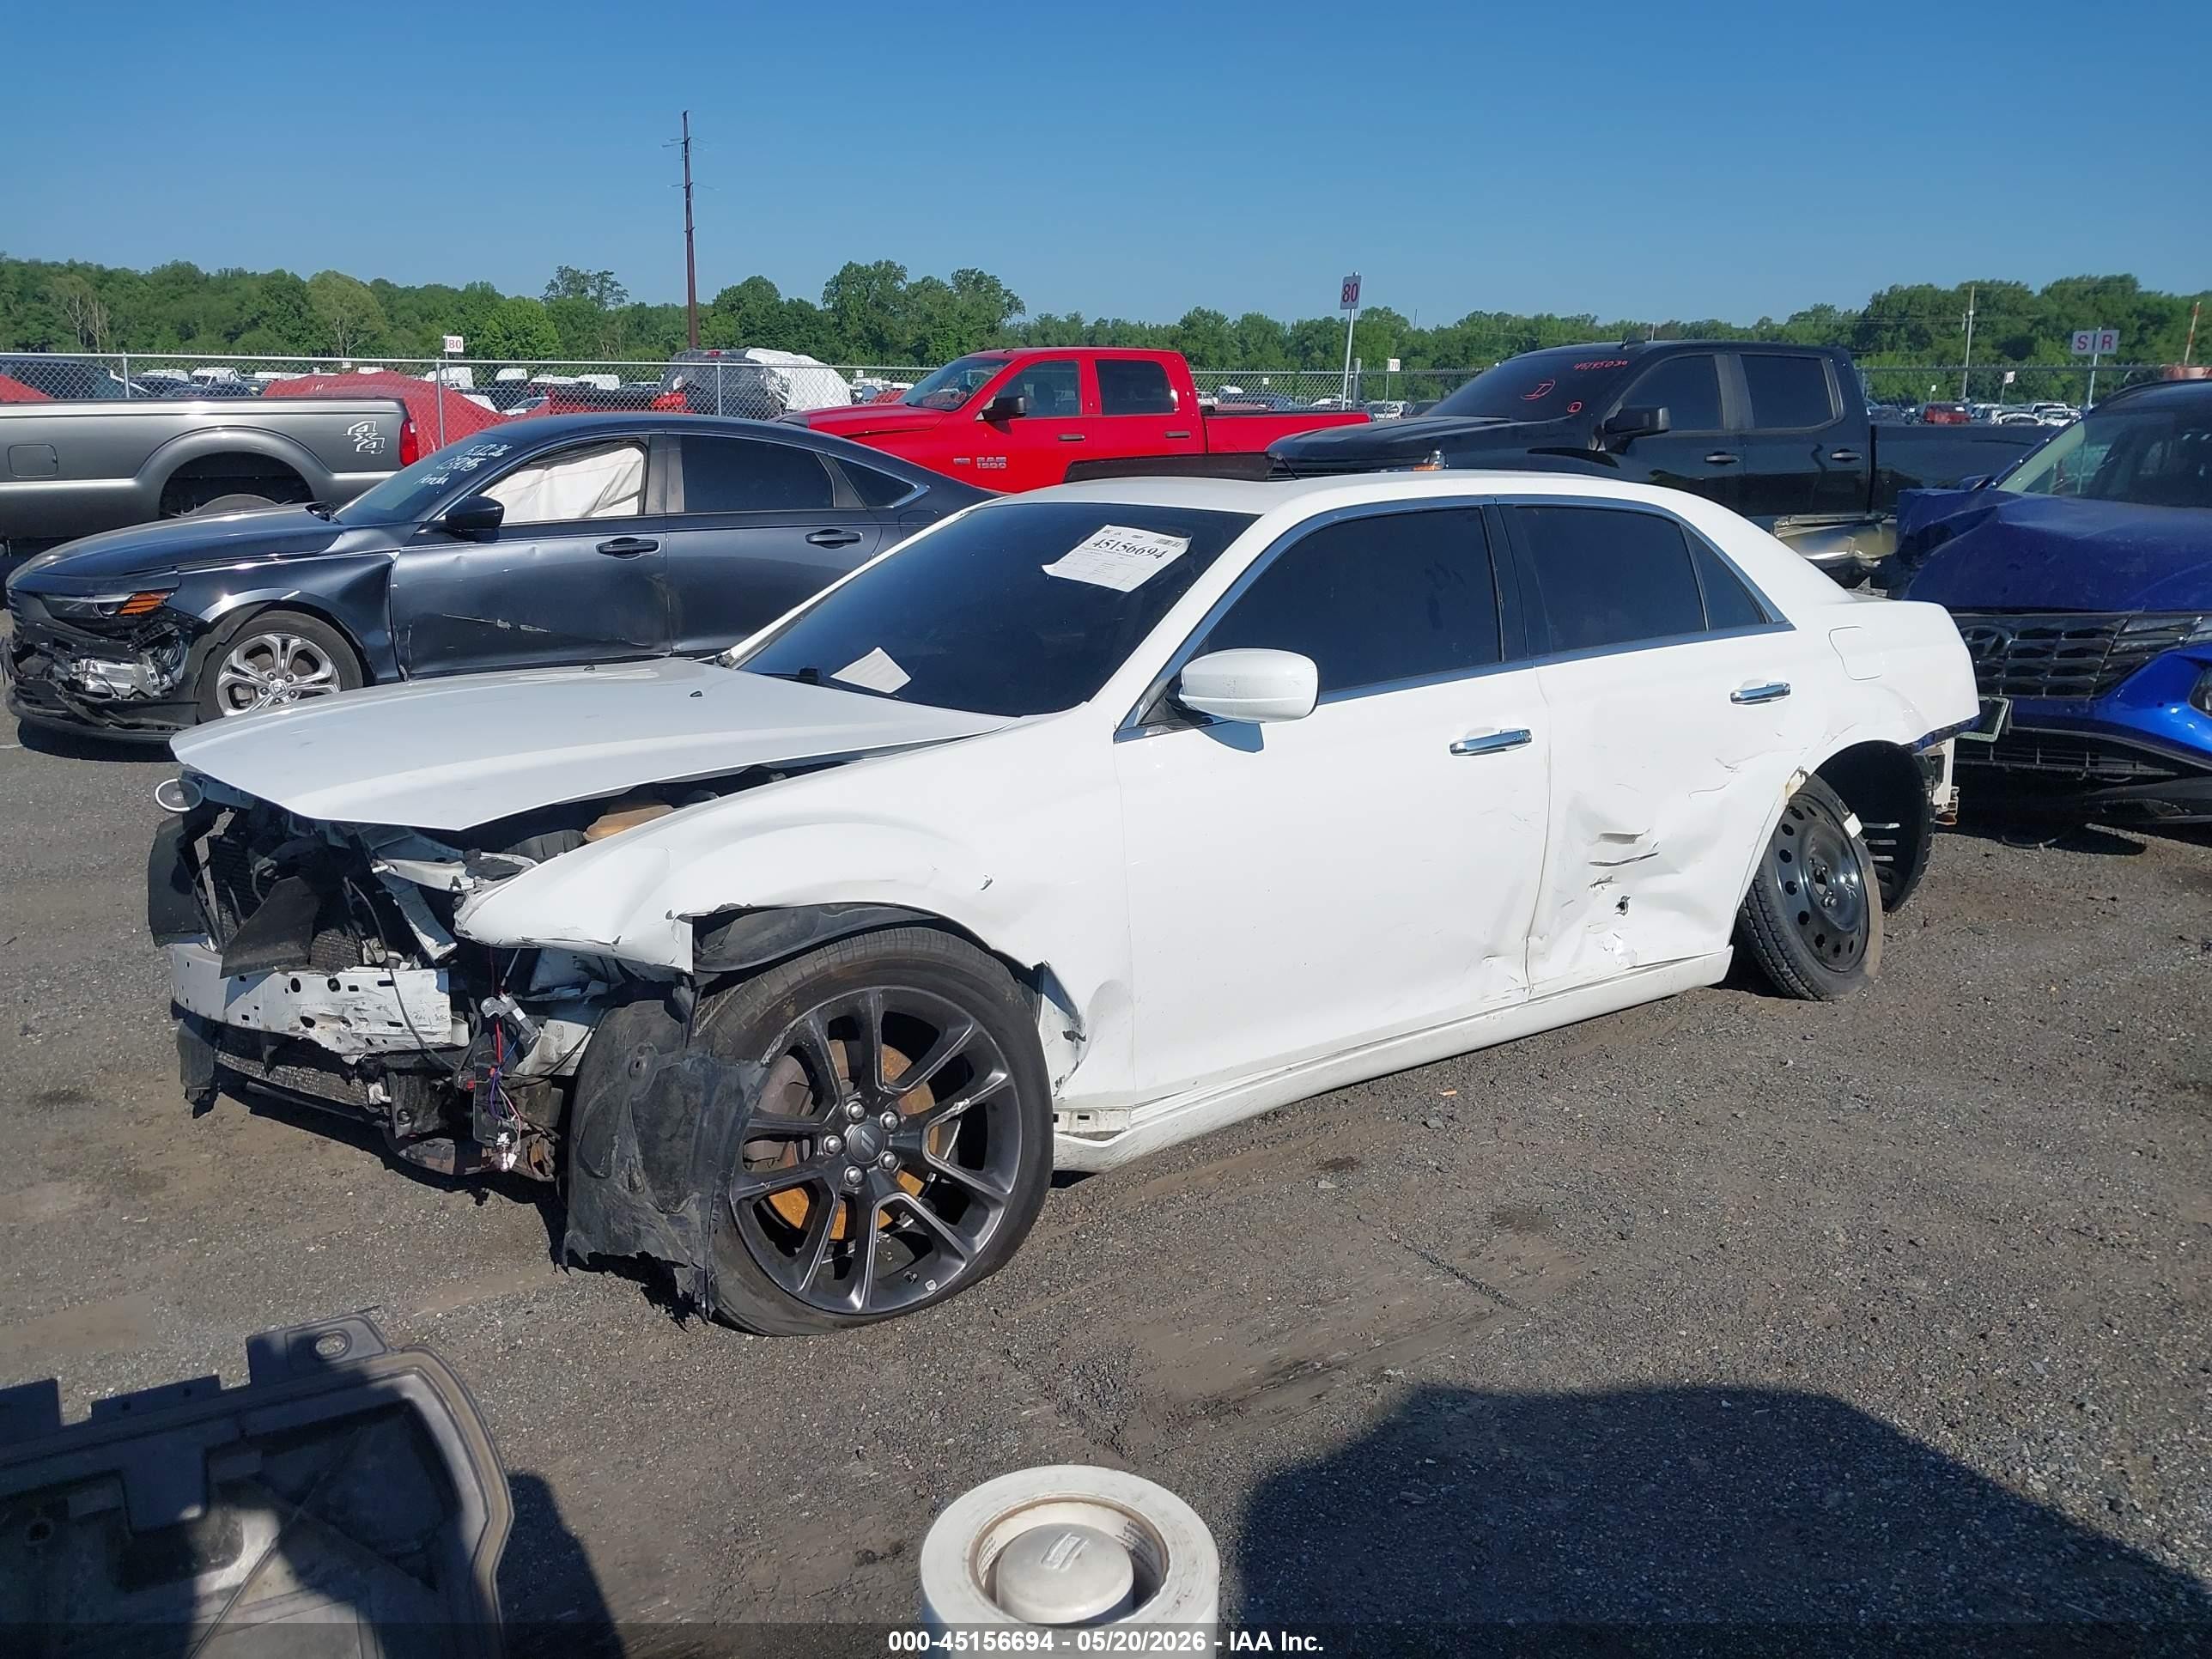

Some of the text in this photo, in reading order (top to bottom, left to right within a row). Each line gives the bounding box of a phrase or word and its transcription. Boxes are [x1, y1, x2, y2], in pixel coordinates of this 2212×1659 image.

[1343, 283, 1358, 302] 80
[448, 339, 462, 349] 80
[2077, 334, 2113, 350] S R
[1091, 538, 1169, 559] 45156694
